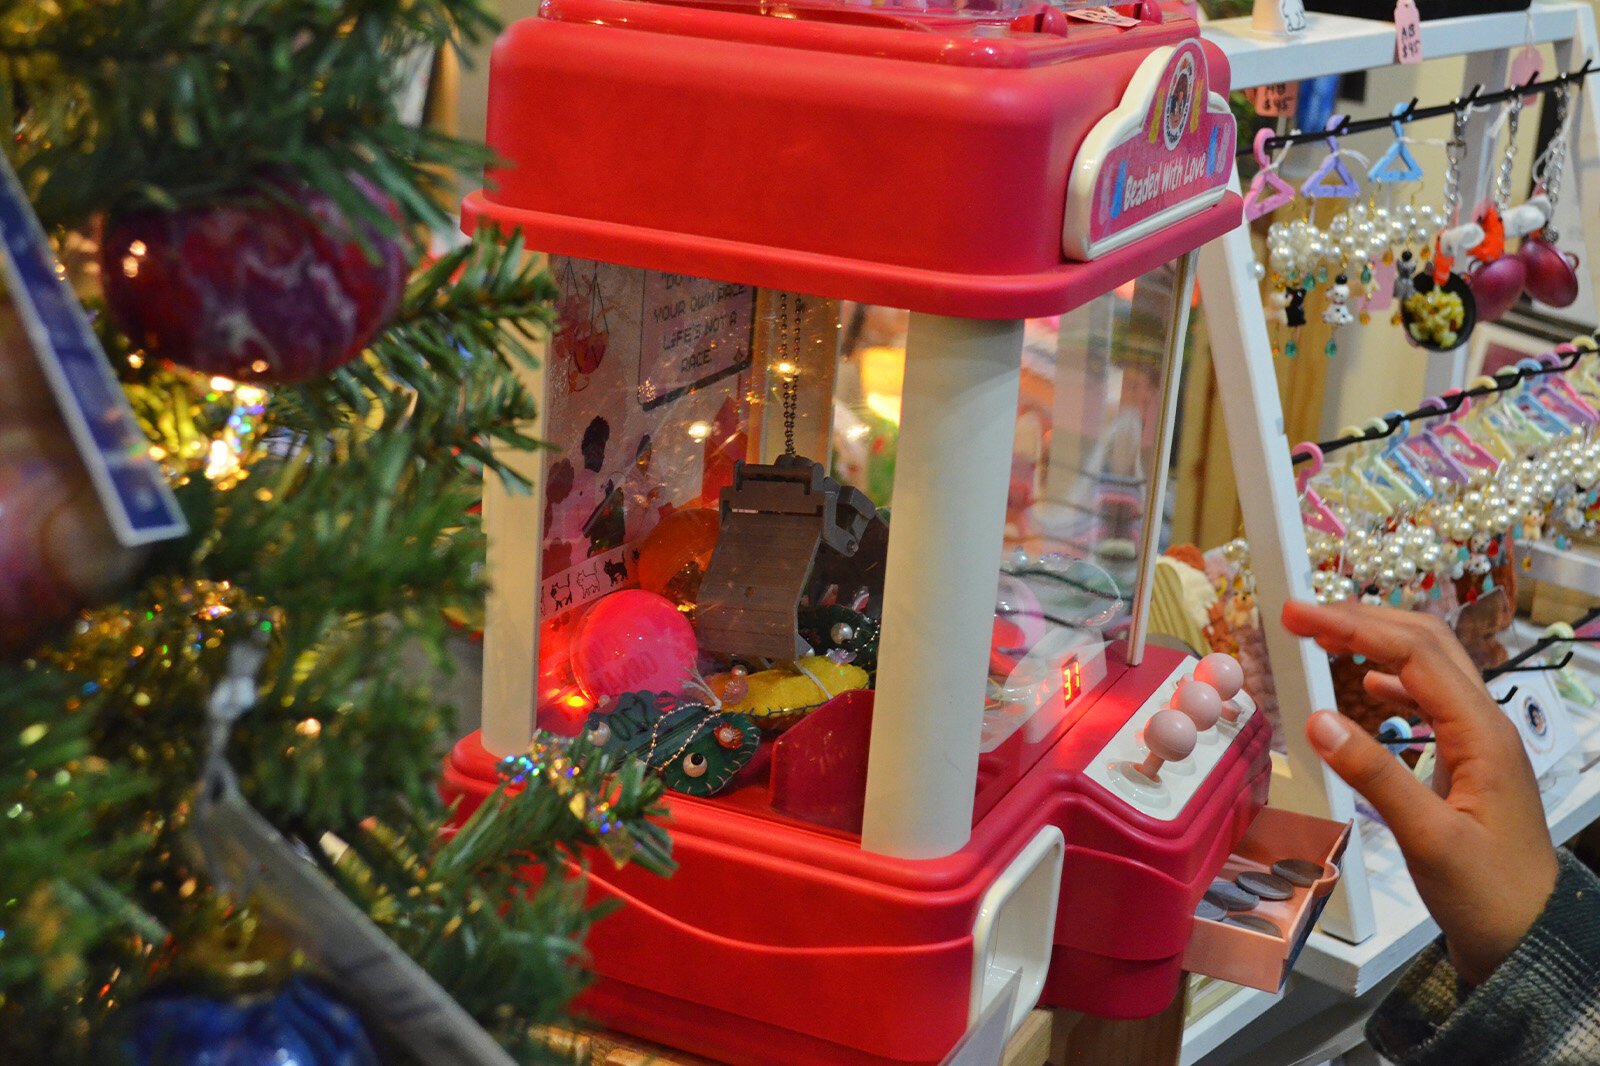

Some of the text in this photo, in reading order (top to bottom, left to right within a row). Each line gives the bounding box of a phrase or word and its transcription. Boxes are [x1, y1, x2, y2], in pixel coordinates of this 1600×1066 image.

[1123, 151, 1206, 212] Beaded With Love
[654, 299, 686, 323] YOUR
[729, 310, 738, 326] A
